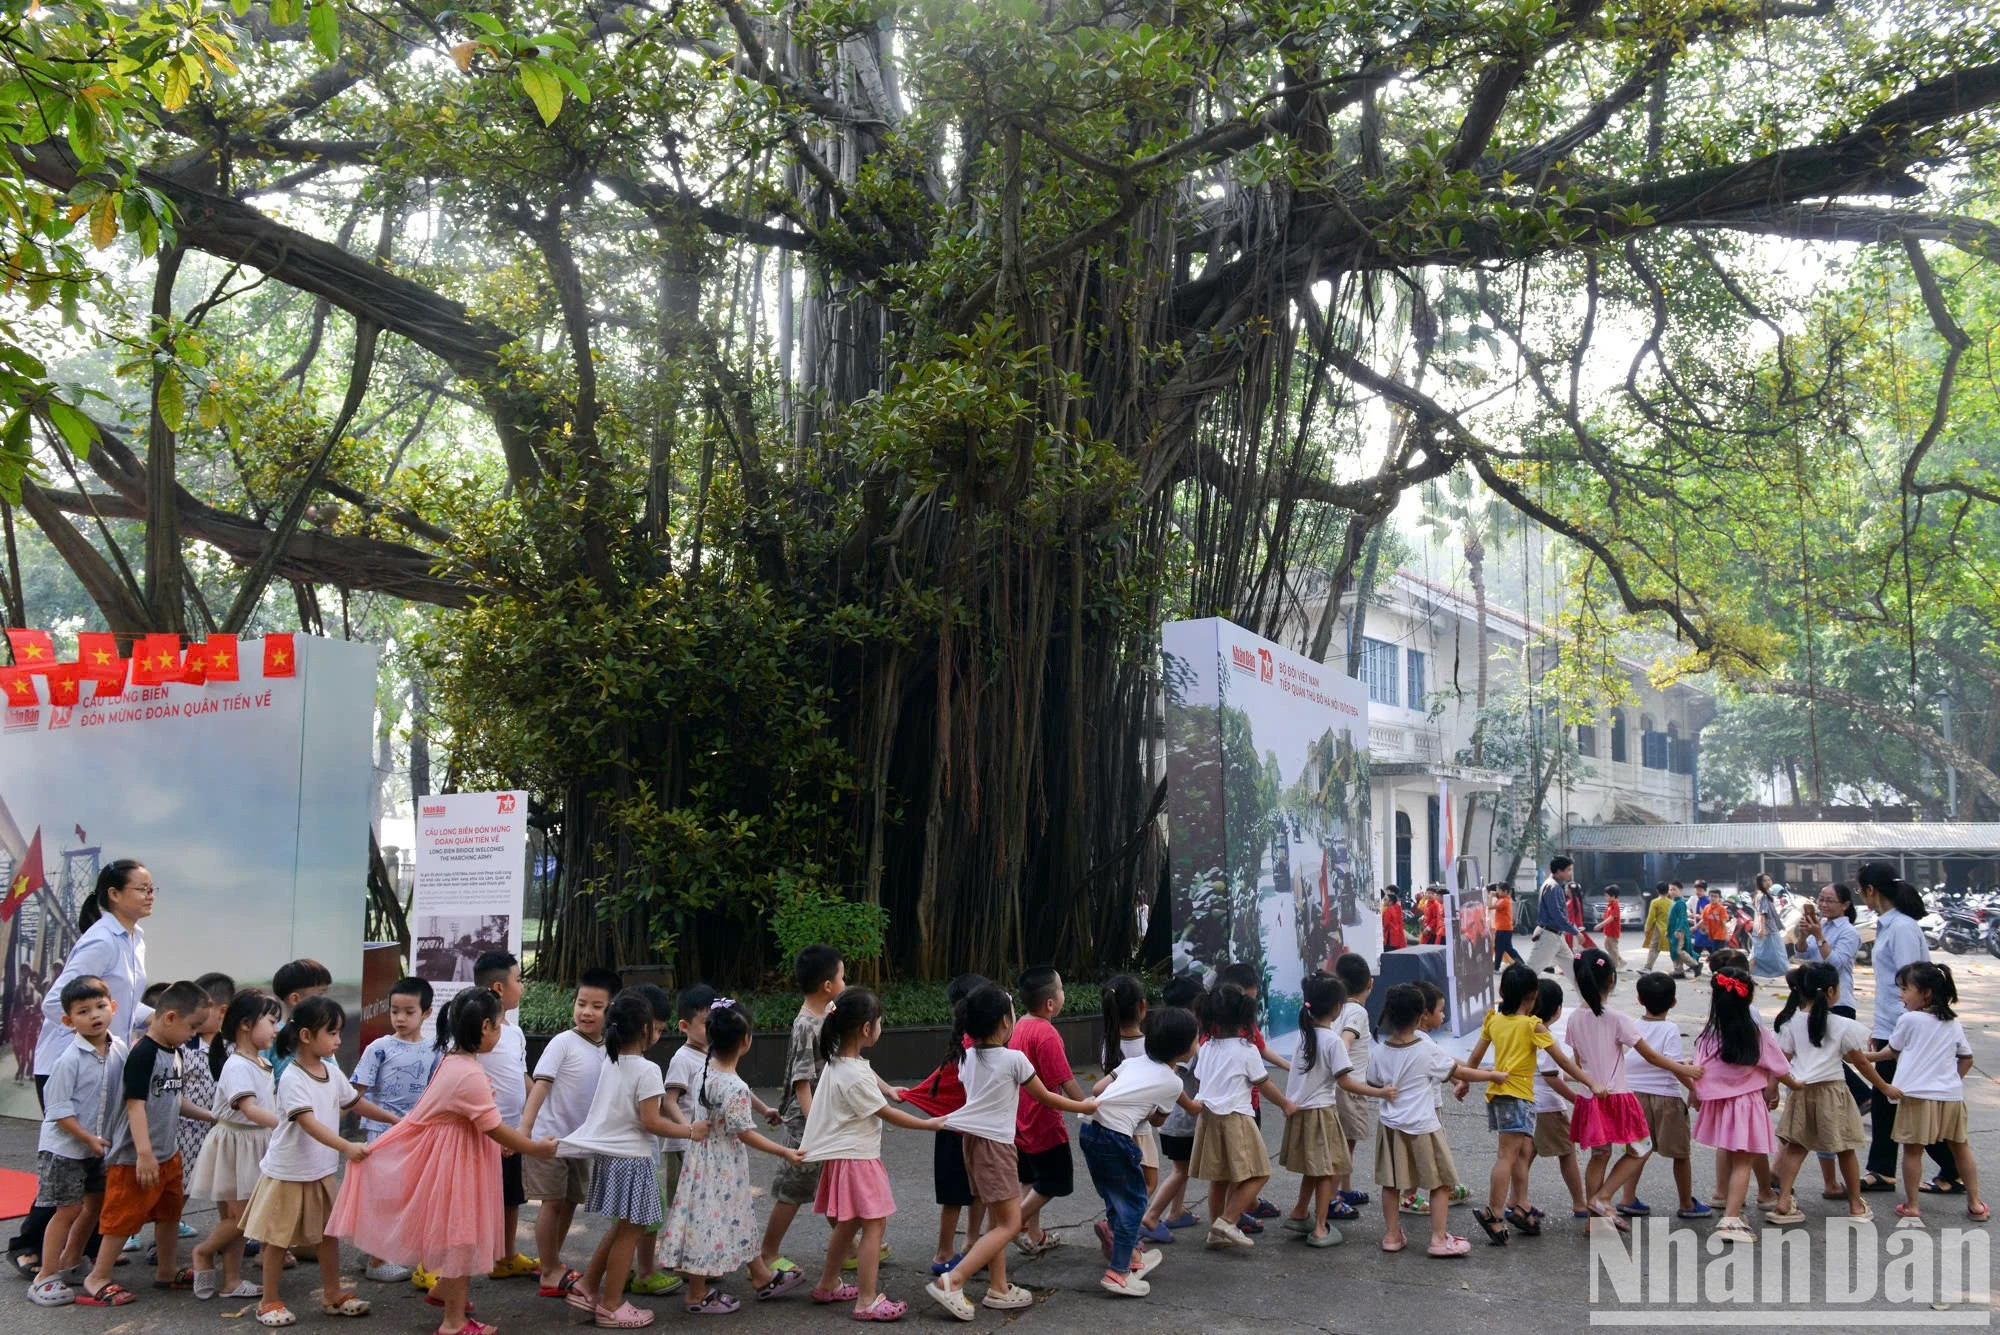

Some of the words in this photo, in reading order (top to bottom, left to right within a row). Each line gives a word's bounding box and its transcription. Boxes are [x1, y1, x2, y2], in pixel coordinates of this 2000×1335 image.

[81, 711, 105, 727] ĐÓN
[108, 707, 142, 724] MỪNG
[145, 702, 180, 720] ĐOÀN
[183, 697, 219, 717] QUÂN
[222, 692, 251, 712] TIẾN
[254, 690, 272, 707] VỀ
[440, 828, 457, 836] LONG
[456, 846, 475, 854] BRIDGE
[475, 845, 505, 853] WELCOMES
[618, 1320, 644, 1328] crocs
